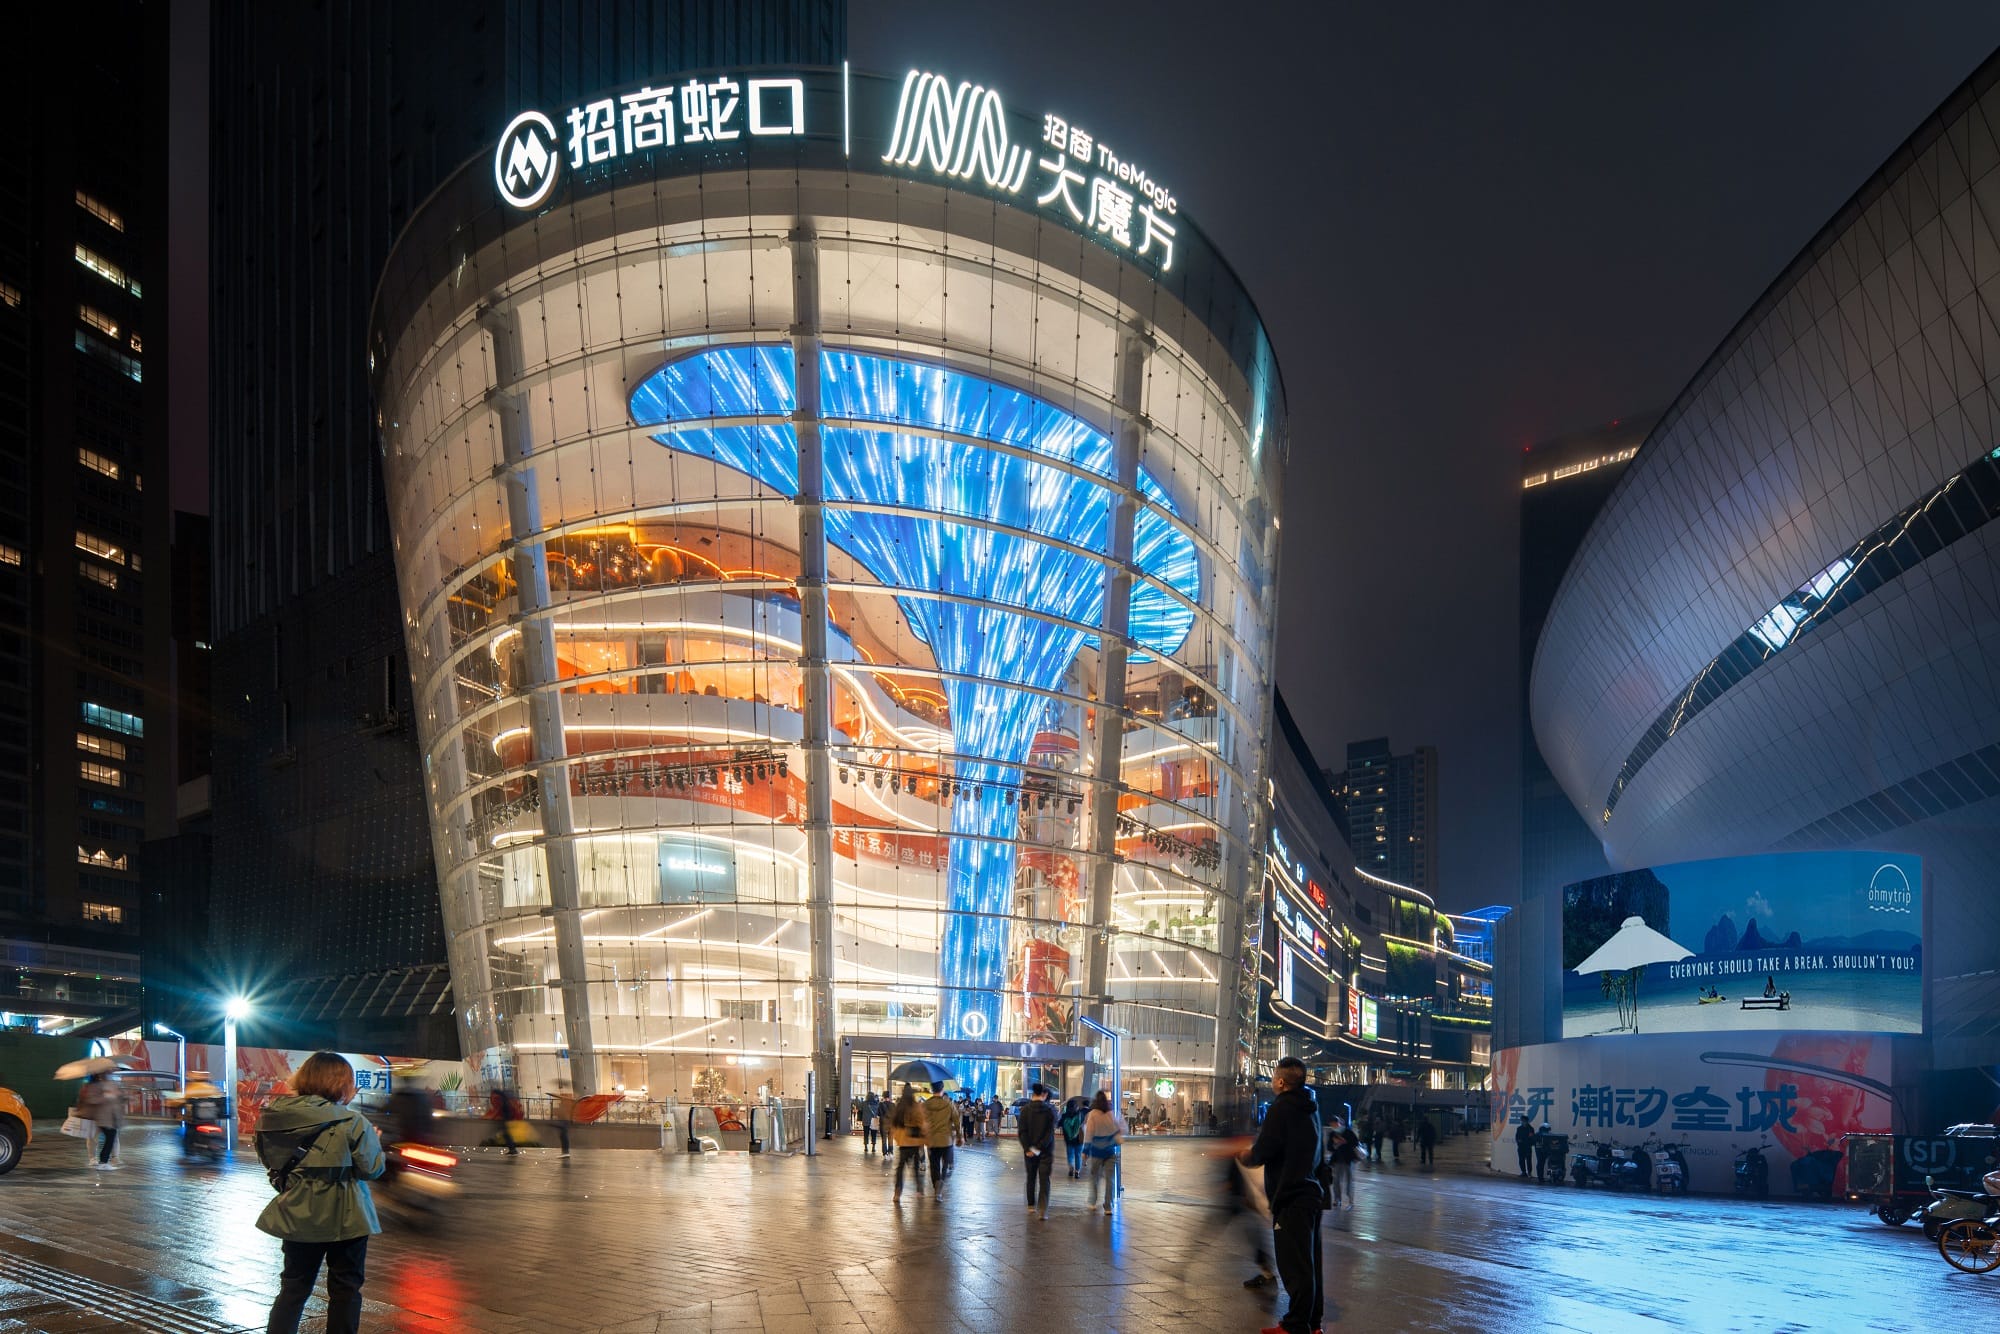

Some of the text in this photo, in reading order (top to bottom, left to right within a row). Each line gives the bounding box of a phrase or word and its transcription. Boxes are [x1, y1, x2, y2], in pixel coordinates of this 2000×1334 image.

[567, 76, 805, 169] 招商蛇口
[1043, 113, 1177, 214] 招商 TheMagic
[1036, 152, 1176, 271] 大魔方
[1869, 886, 1911, 907] ohmytrip
[1670, 955, 1915, 979] EVERYONE SHOULD TAKE A BREAK. SHOULDN'T YOU?
[355, 1069, 388, 1089] 魔方
[1570, 1082, 1798, 1132] 潮动全城
